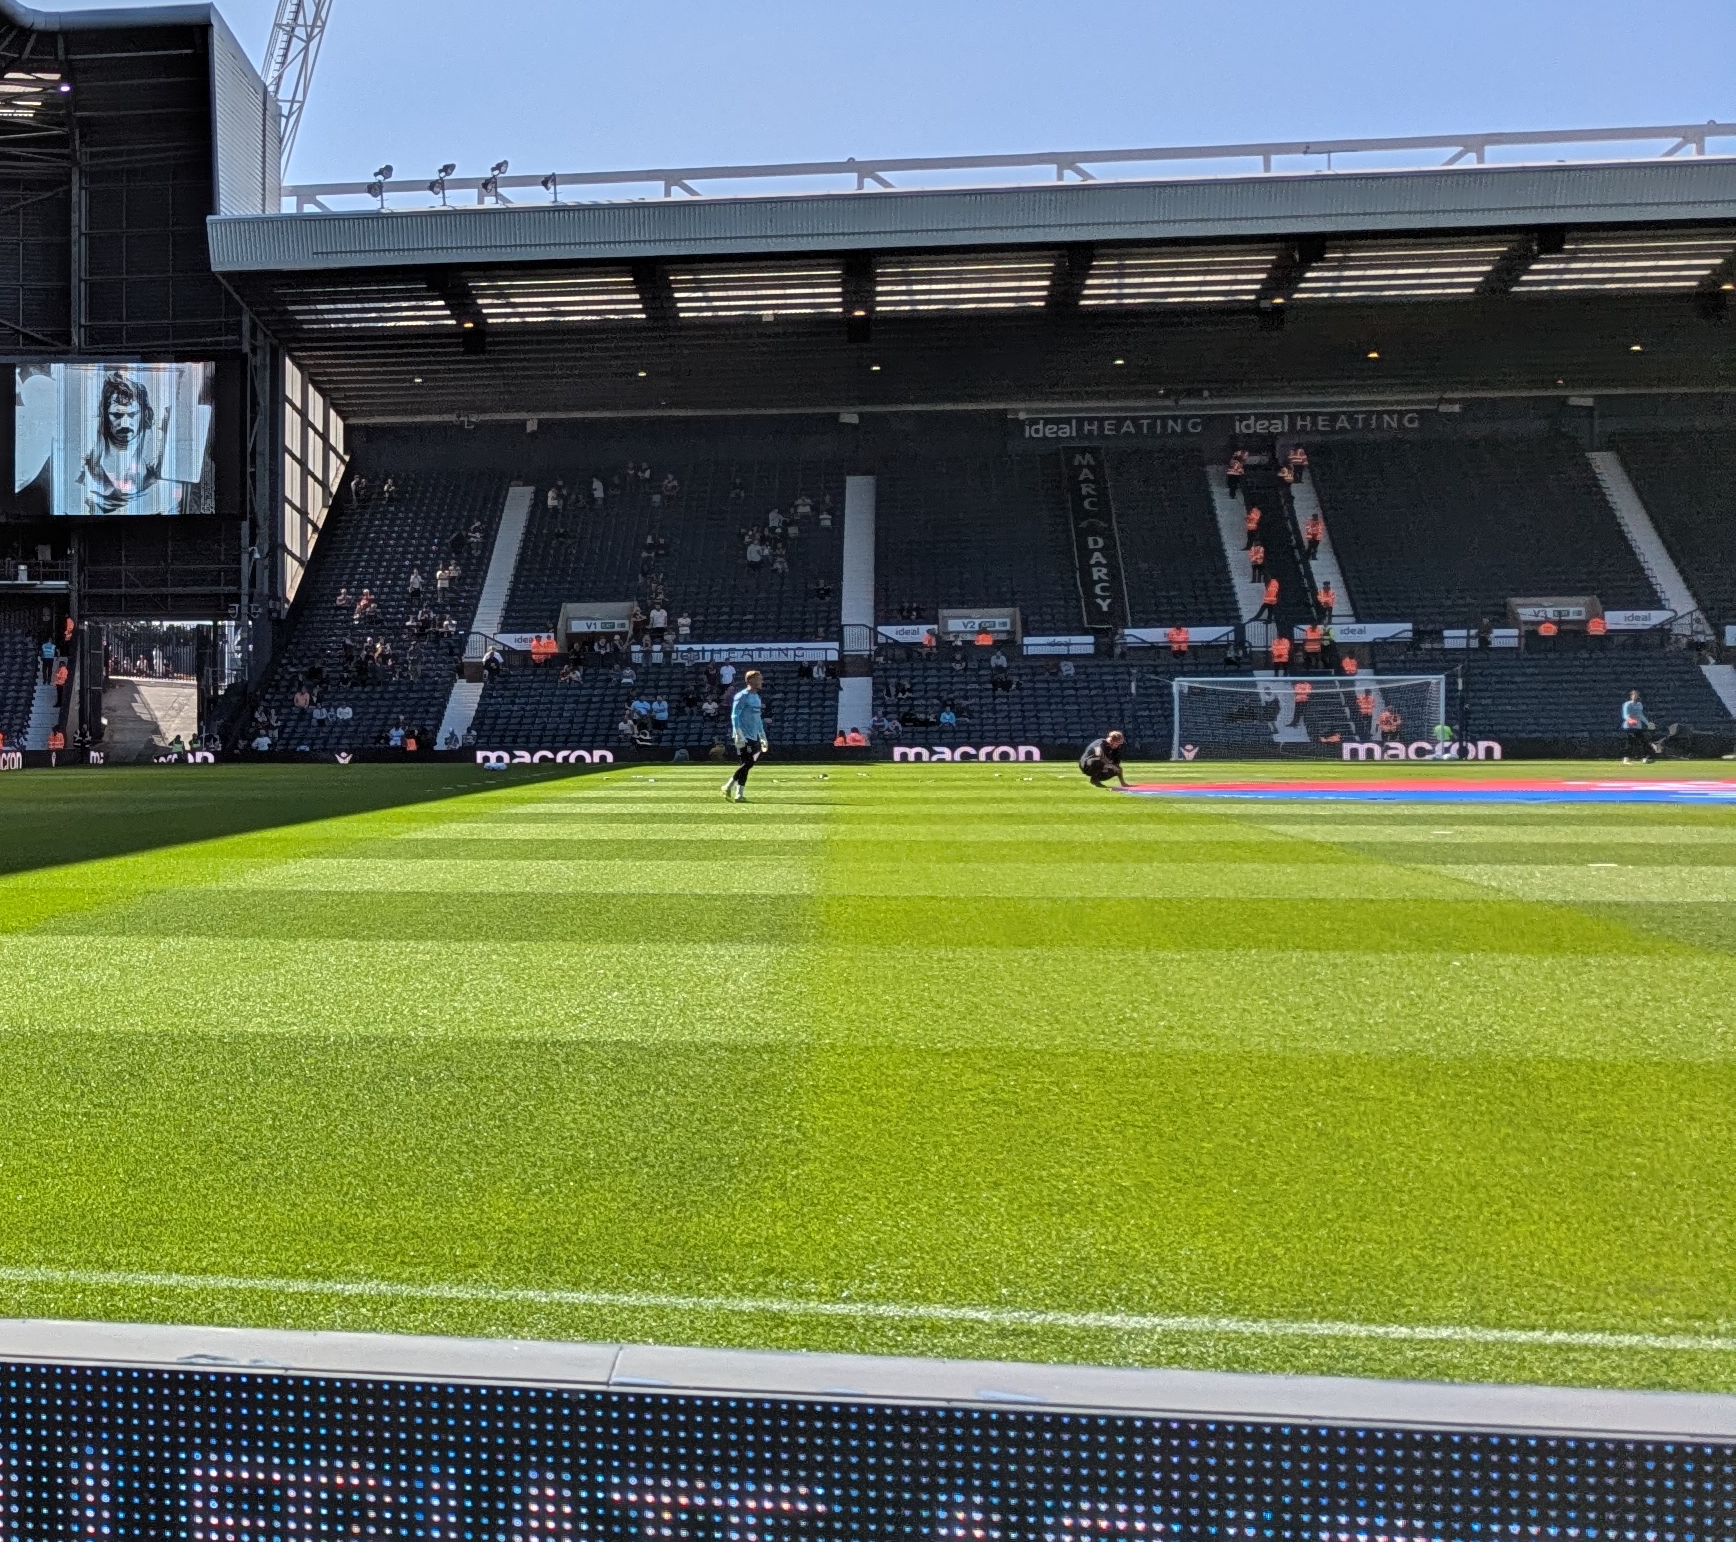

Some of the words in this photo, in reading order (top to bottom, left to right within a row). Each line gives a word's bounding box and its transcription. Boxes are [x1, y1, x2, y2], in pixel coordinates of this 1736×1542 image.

[1024, 420, 1077, 439] ideal
[1083, 418, 1203, 437] HEATING
[1234, 415, 1289, 435] ideal
[1296, 413, 1421, 433] HEATING
[1073, 453, 1099, 511] MARC
[1087, 536, 1112, 612] DARCY
[585, 621, 597, 630] V1
[961, 620, 976, 629] V2
[1339, 626, 1366, 635] ideal
[476, 749, 614, 764] macron
[893, 745, 1041, 762] macron
